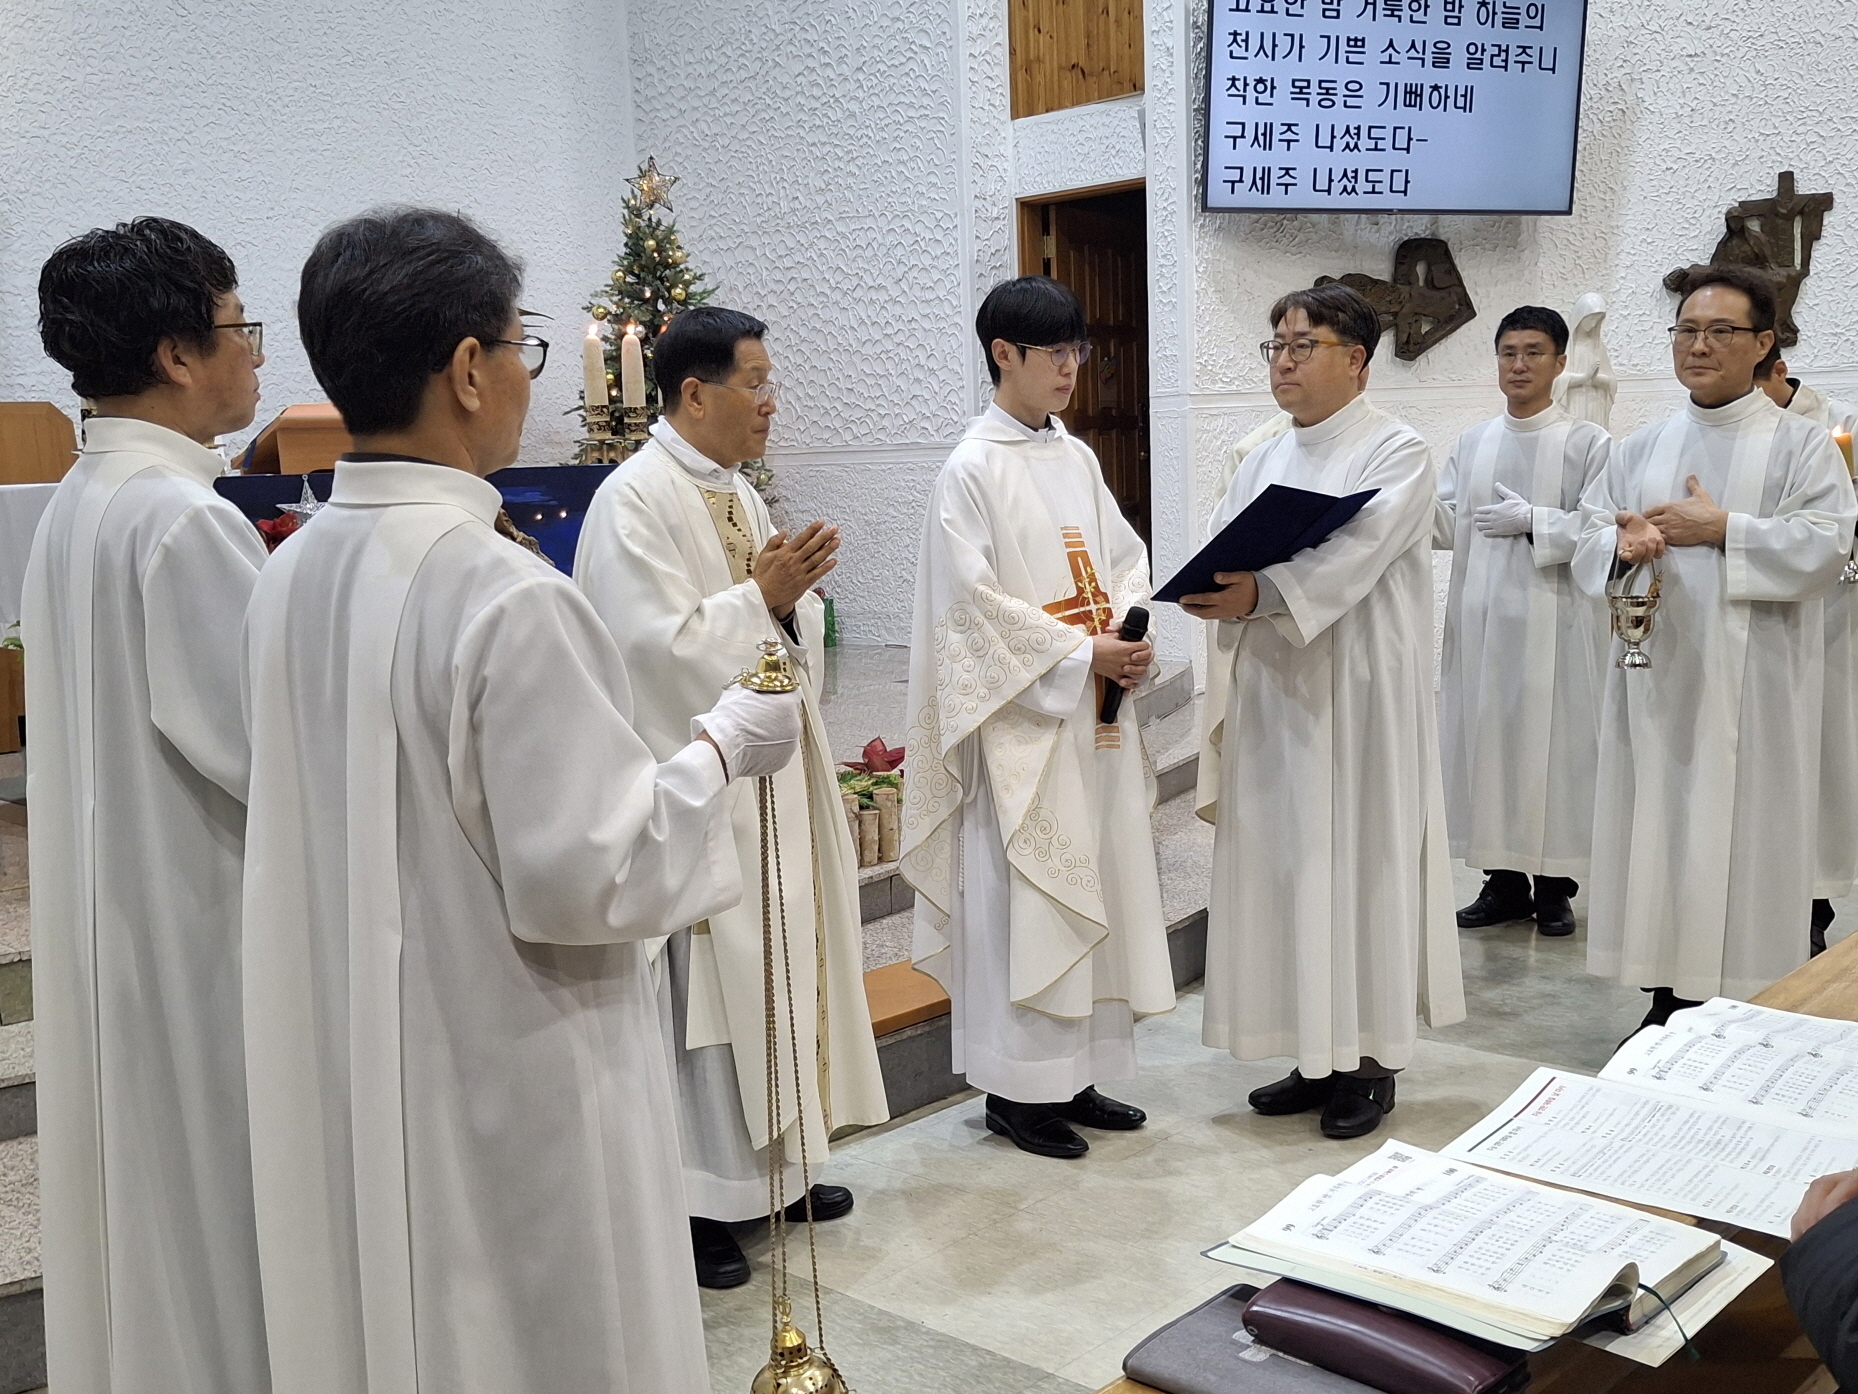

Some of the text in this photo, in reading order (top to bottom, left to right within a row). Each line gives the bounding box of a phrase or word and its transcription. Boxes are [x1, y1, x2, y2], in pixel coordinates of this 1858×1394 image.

[1355, 0, 1431, 25] 거룩한
[1443, 0, 1465, 27] 밤
[1476, 0, 1545, 31] 하늘의
[1226, 29, 1558, 75] 천사가 기쁜 소식을 알려주니
[1225, 75, 1475, 114] 착한 목동은 기뻐하네
[1223, 120, 1429, 155] 구세주 나셨도다-
[1222, 165, 1412, 197] 구세주 나셨도다
